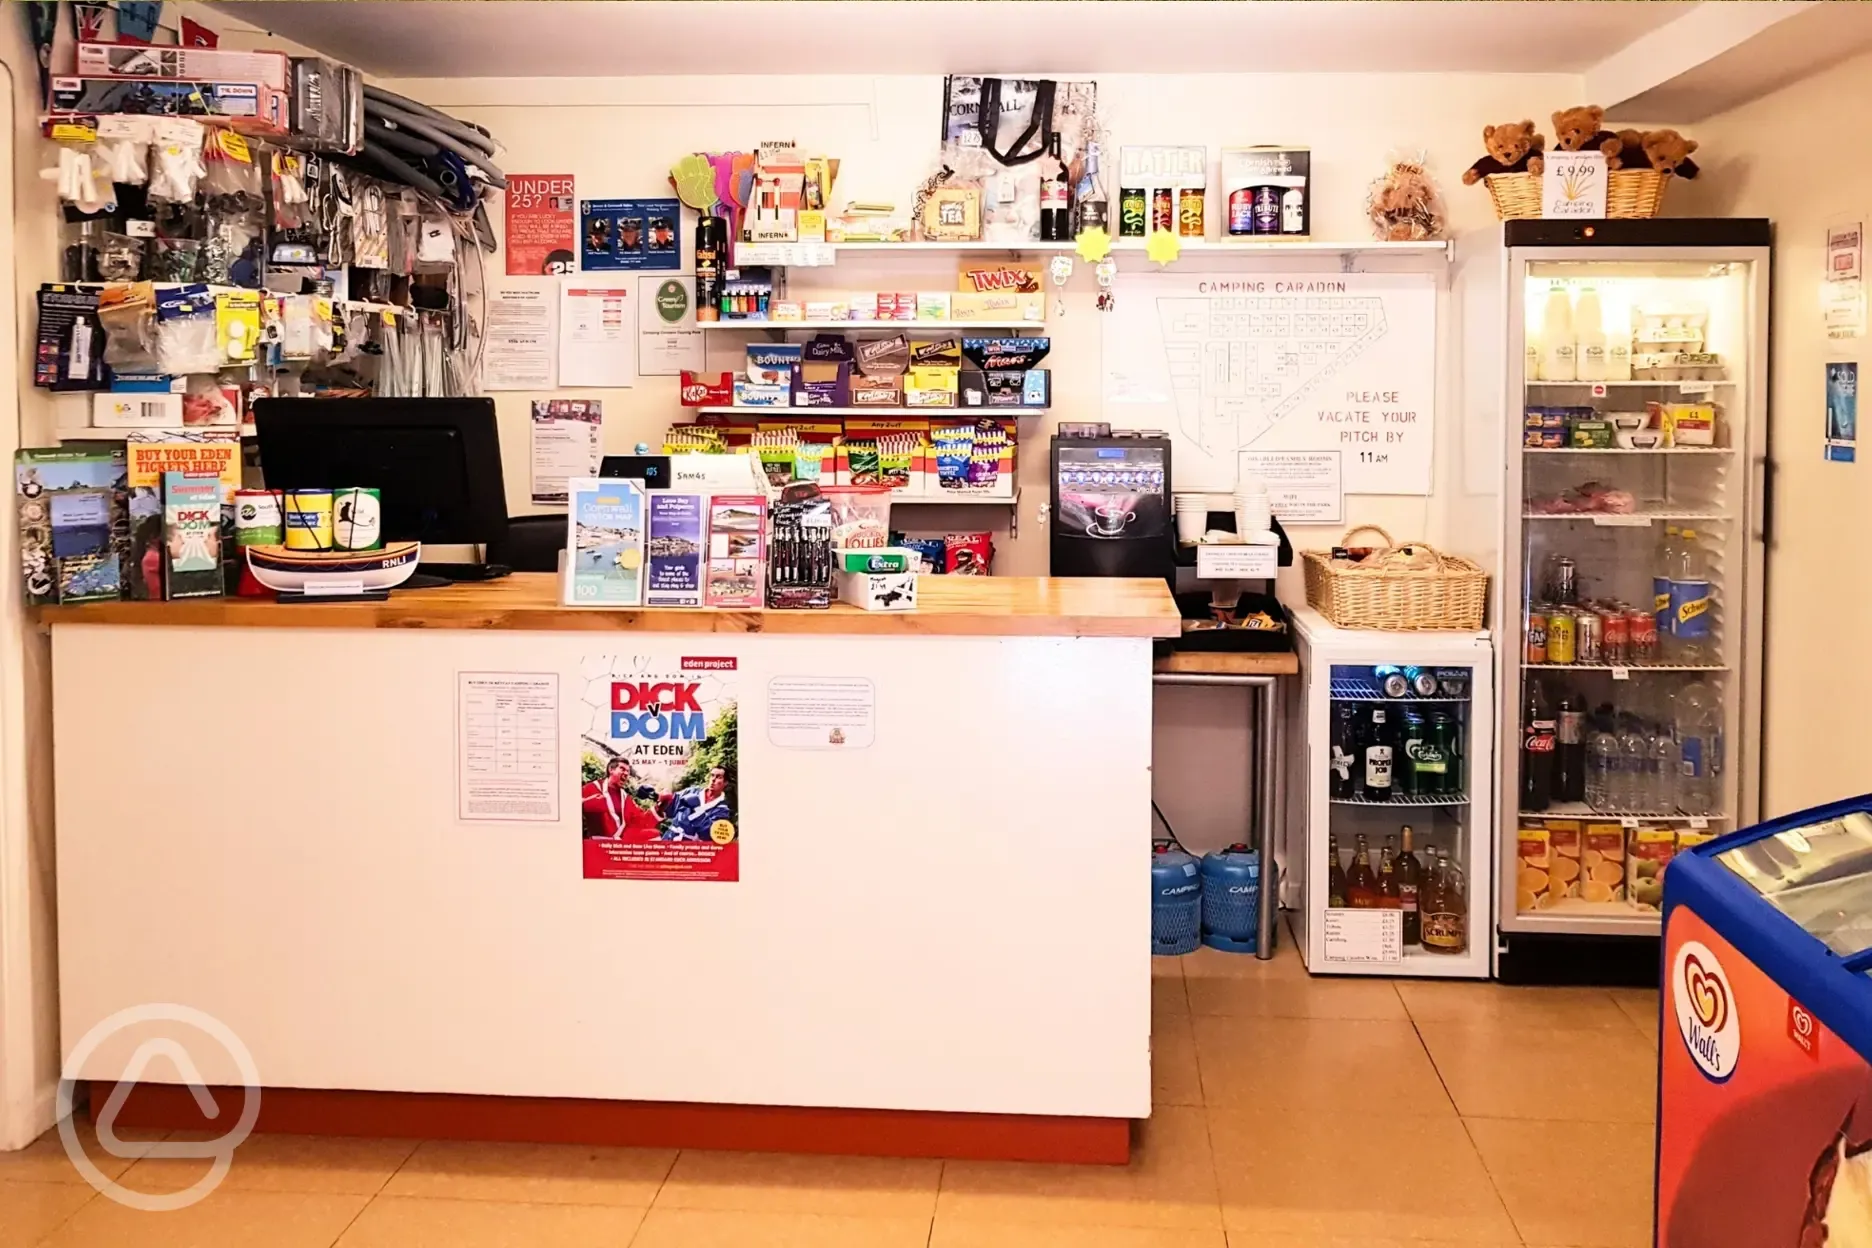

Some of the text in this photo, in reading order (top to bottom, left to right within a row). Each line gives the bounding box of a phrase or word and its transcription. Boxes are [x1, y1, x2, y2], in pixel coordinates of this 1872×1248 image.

[949, 98, 1021, 117] CORNALL
[511, 180, 574, 194] UNDER
[511, 194, 542, 208] 25?
[1199, 282, 1346, 293] CAMPING CARADON
[812, 347, 845, 356] Dairy Milk
[756, 355, 790, 365] BOUNT
[1346, 391, 1400, 403] PLEASE
[1317, 411, 1417, 423] VACATE YOUR
[1340, 431, 1404, 443] PITCH BY
[136, 449, 232, 461] BUY YOUR EDEN
[137, 461, 227, 473] TICKETS HERE
[171, 485, 215, 494] Summer
[583, 503, 632, 513] Cornwall
[177, 511, 209, 522] DICK
[845, 536, 884, 549] LOLLIES
[382, 555, 407, 569] RNLI
[871, 560, 900, 569] Extra
[576, 585, 598, 596] 100
[683, 660, 734, 669] eden project
[611, 682, 703, 712] DICK
[611, 712, 706, 740] DOM
[635, 745, 684, 755] AT EDEN
[1375, 766, 1388, 774] JOB
[1688, 1016, 1721, 1072] Wall's
